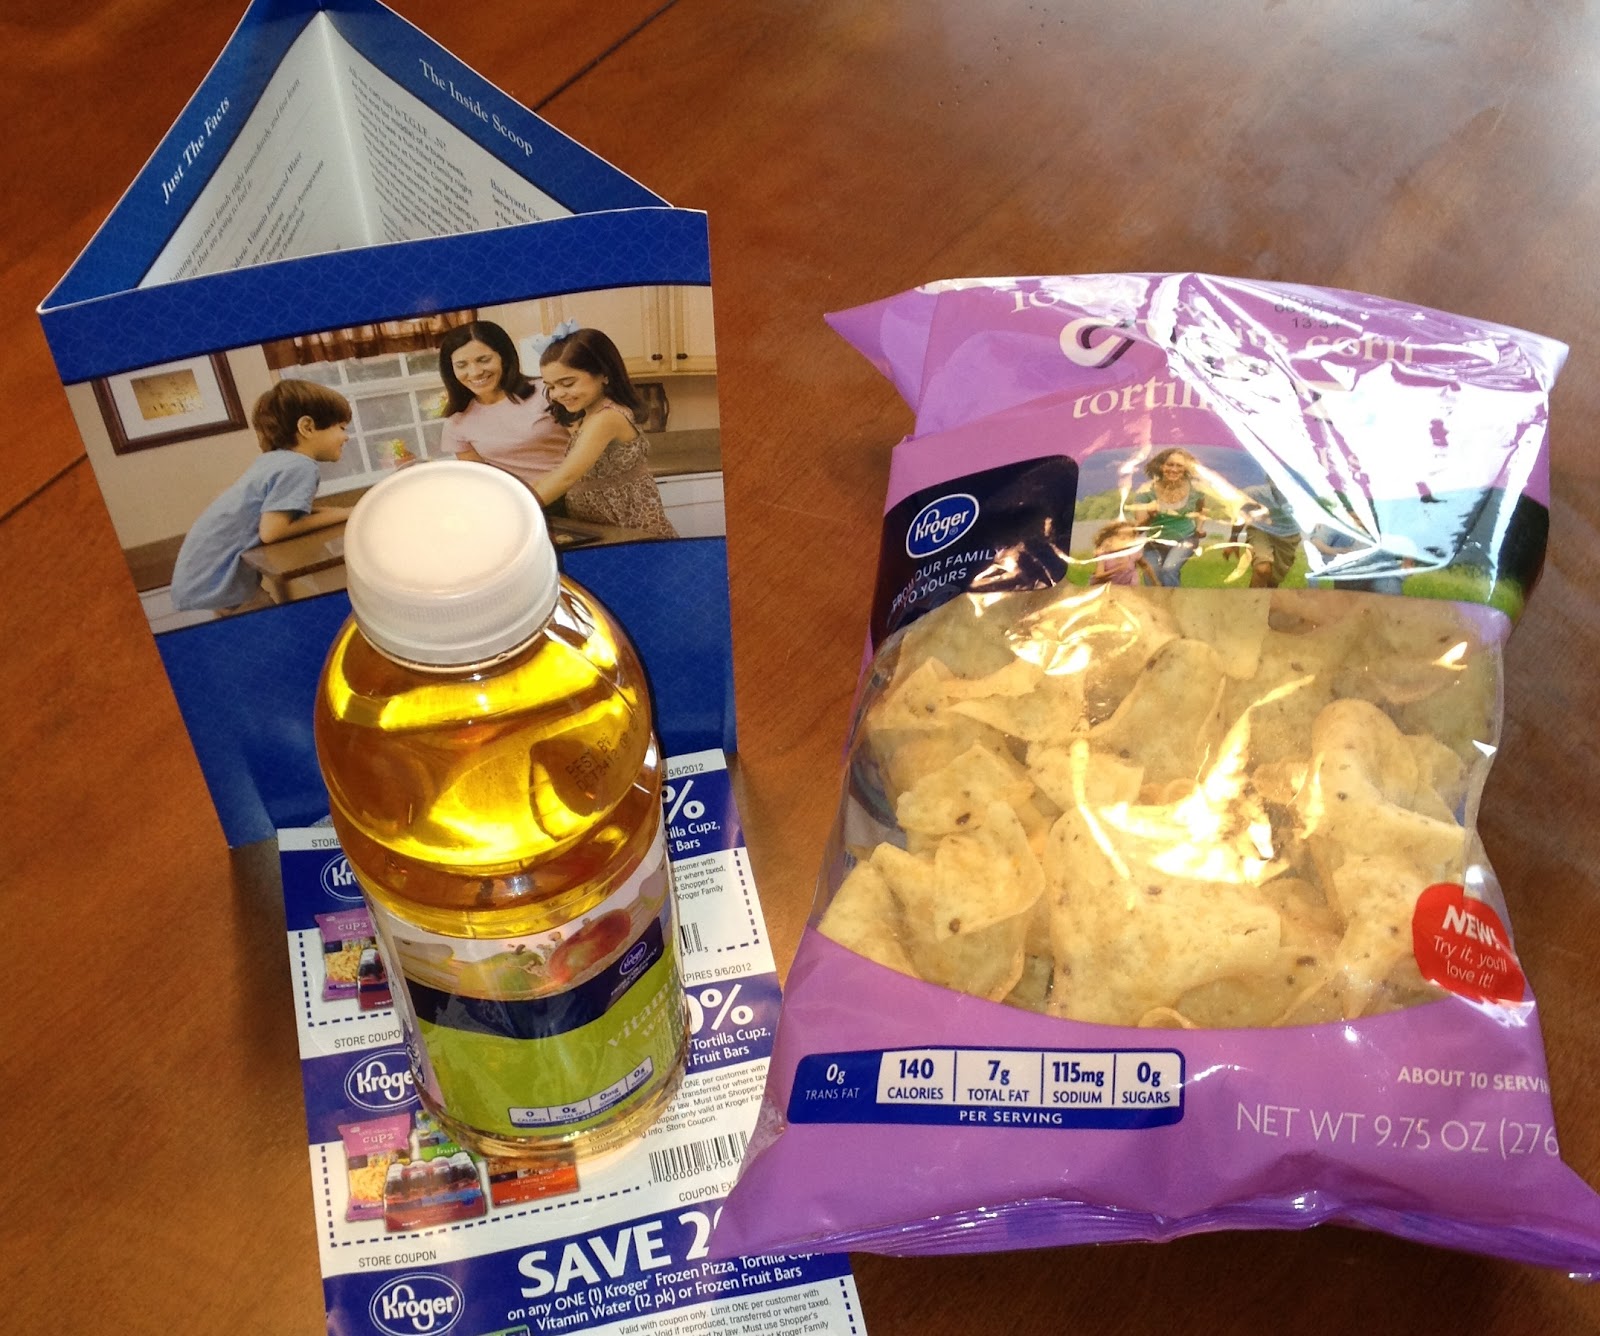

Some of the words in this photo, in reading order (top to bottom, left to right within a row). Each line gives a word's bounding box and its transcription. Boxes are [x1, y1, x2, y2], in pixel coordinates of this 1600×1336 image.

[419, 58, 446, 91] The
[448, 80, 489, 123] Inside
[492, 113, 533, 157] Scoop
[161, 165, 184, 204] Just
[182, 132, 205, 166] The
[203, 97, 230, 137] Facts
[913, 508, 970, 543] Kroger
[915, 559, 941, 582] OUR
[945, 548, 1004, 568] FAMILY
[920, 567, 967, 597] YOURS
[668, 763, 704, 777] 9/6/2012
[688, 820, 720, 835] Cupz,
[311, 837, 342, 848] STORE
[675, 838, 701, 852] Bars
[701, 857, 716, 867] with
[680, 877, 715, 892] Shopper's
[684, 869, 704, 881] where
[701, 884, 724, 897] Family
[1442, 904, 1501, 950] NEW!
[1434, 935, 1457, 959] Try
[1460, 945, 1473, 964] it,
[715, 963, 752, 977] 9/6/2012
[1447, 960, 1475, 981] love
[1479, 971, 1494, 988] it!
[334, 1035, 365, 1049] STORE
[368, 1029, 403, 1045] COUPO
[692, 1032, 734, 1050] Tortilla
[736, 1027, 771, 1041] Cupz,
[693, 1051, 721, 1066] Fruit
[725, 1045, 750, 1058] Bars
[685, 1078, 701, 1089] ONE
[702, 1076, 714, 1086] per
[716, 1069, 749, 1082] customer
[750, 1064, 766, 1074] with
[826, 1064, 846, 1084] 0g
[899, 1058, 934, 1080] 140
[987, 1059, 1011, 1085] 7g
[1052, 1061, 1105, 1087] 115mg
[1137, 1061, 1161, 1087] 0g
[1397, 1066, 1465, 1088] ABOUT
[1469, 1072, 1488, 1089] 10
[356, 1061, 414, 1101] Kroge
[682, 1084, 721, 1098] transferred
[731, 1076, 753, 1087] where
[667, 1104, 675, 1113] by
[693, 1096, 712, 1106] Must
[713, 1092, 727, 1101] use
[728, 1084, 764, 1098] Shopper's
[805, 1088, 838, 1100] TRANS
[841, 1087, 860, 1099] FAT
[887, 1087, 944, 1100] CALORIES
[967, 1088, 1006, 1102] TOTAL
[1008, 1089, 1030, 1103] FAT
[1052, 1090, 1103, 1104] SODIUM
[1121, 1091, 1171, 1104] SUGARS
[654, 1112, 679, 1124] oupon
[681, 1108, 697, 1119] only
[698, 1104, 714, 1114] valid
[725, 1096, 748, 1110] Kroger
[959, 1109, 990, 1122] PER
[993, 1110, 1063, 1124] SERVING
[666, 1122, 686, 1132] Store
[687, 1115, 717, 1128] Coupon.
[1236, 1101, 1300, 1138] NET
[1309, 1108, 1365, 1144] WT
[1374, 1114, 1431, 1151] 9.75
[1440, 1120, 1489, 1153] OZ
[1499, 1117, 1560, 1161] (276
[362, 1133, 394, 1143] cupz
[679, 1184, 719, 1202] COUPON
[721, 1180, 736, 1192] EX
[358, 1257, 391, 1268] STORE
[394, 1250, 437, 1265] COUPON
[517, 1219, 672, 1299] SAVE
[678, 1206, 723, 1260] 2
[507, 1307, 526, 1322] on
[528, 1302, 552, 1319] any
[554, 1292, 586, 1311] ONE
[588, 1288, 602, 1306] (1)
[604, 1278, 648, 1299] Kroger
[655, 1268, 700, 1287] Frozen
[701, 1260, 738, 1277] Pizza,
[536, 1310, 589, 1331] Vitamin
[591, 1299, 631, 1319] Water
[634, 1293, 653, 1312] (12
[655, 1288, 676, 1308] pk)
[678, 1288, 692, 1299] or
[695, 1278, 739, 1295] Frozen
[741, 1271, 772, 1288] Fruit
[774, 1266, 802, 1282] Bars
[382, 1284, 454, 1331] Kroger
[619, 1323, 639, 1336] Valid
[640, 1321, 658, 1331] with
[659, 1315, 689, 1328] coupon
[690, 1310, 709, 1322] only.
[710, 1306, 730, 1317] Limit
[731, 1302, 750, 1312] ONE
[751, 1300, 764, 1311] per
[765, 1294, 801, 1308] customer
[802, 1289, 820, 1300] with
[682, 1318, 729, 1335] reproduced,
[729, 1309, 772, 1325] transferred
[773, 1309, 781, 1317] or
[782, 1303, 808, 1317] where
[743, 1322, 762, 1335] Must
[764, 1321, 778, 1330] use
[779, 1312, 818, 1329] Shopper's
[804, 1320, 829, 1336] Family
